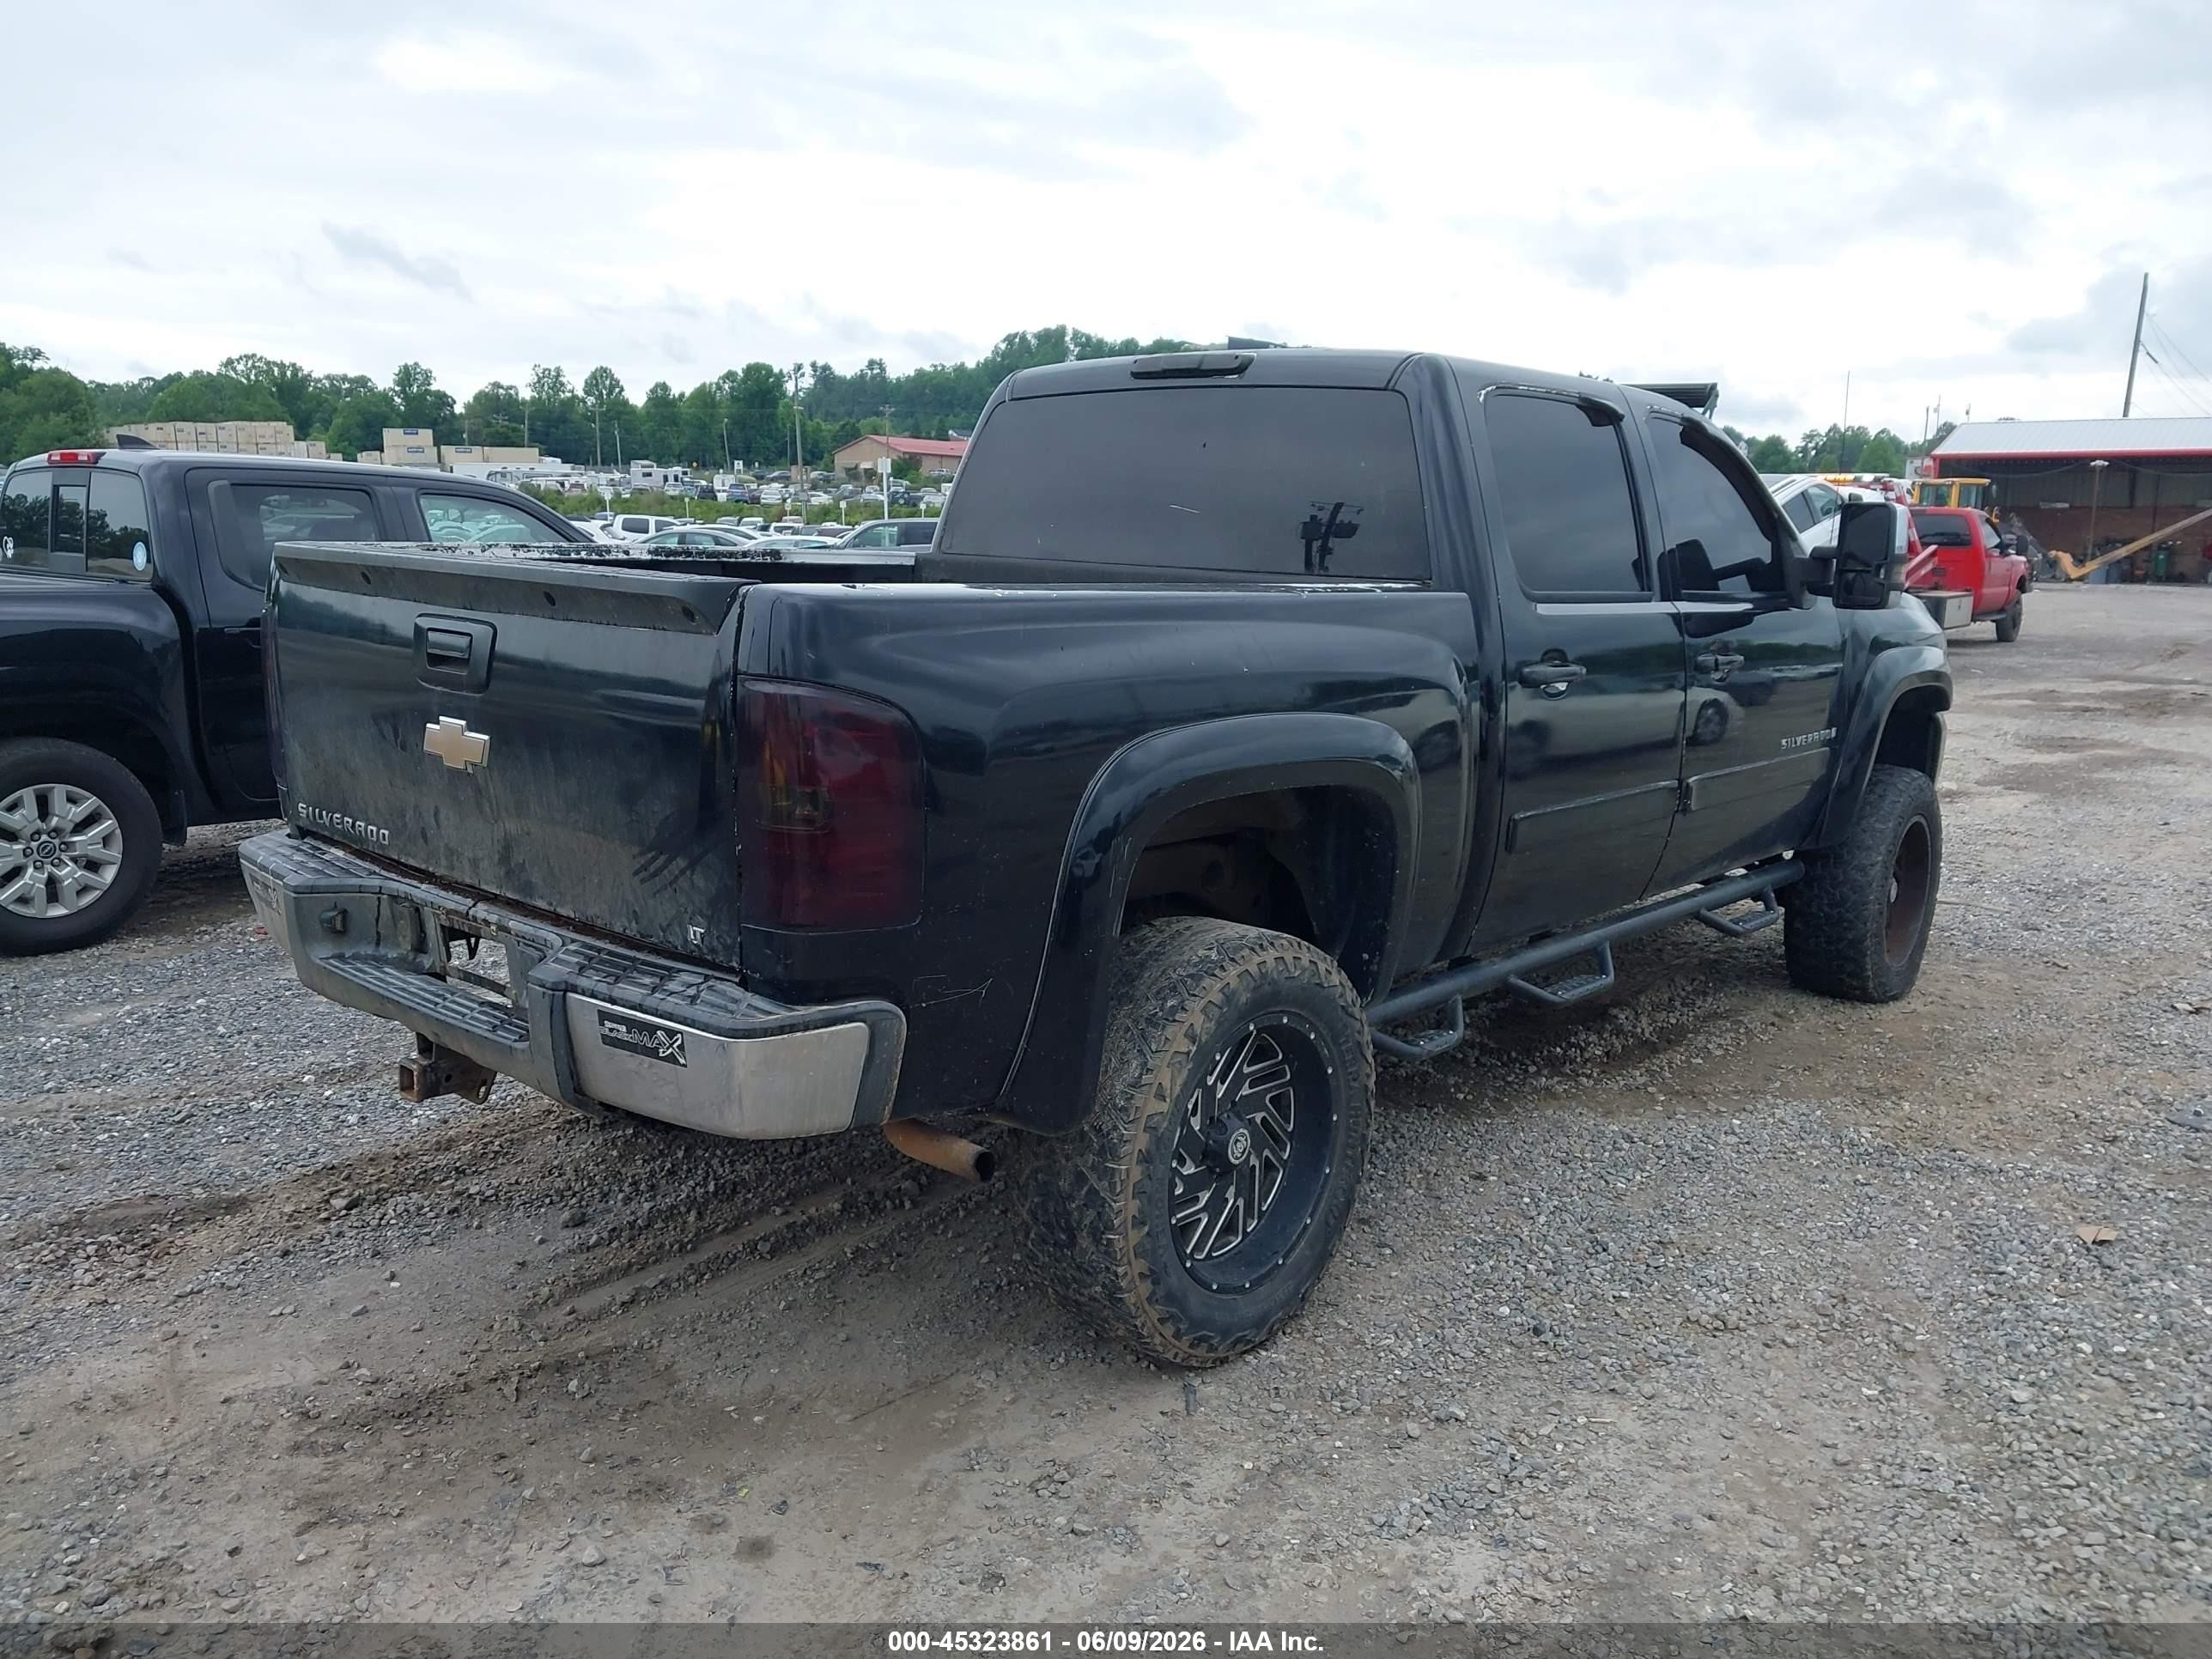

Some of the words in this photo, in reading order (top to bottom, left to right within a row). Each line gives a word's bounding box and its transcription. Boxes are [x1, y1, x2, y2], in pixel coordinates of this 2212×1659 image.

[1781, 726, 1838, 750] SILVERADO
[297, 801, 390, 846] SILVERADO
[687, 924, 705, 946] LT
